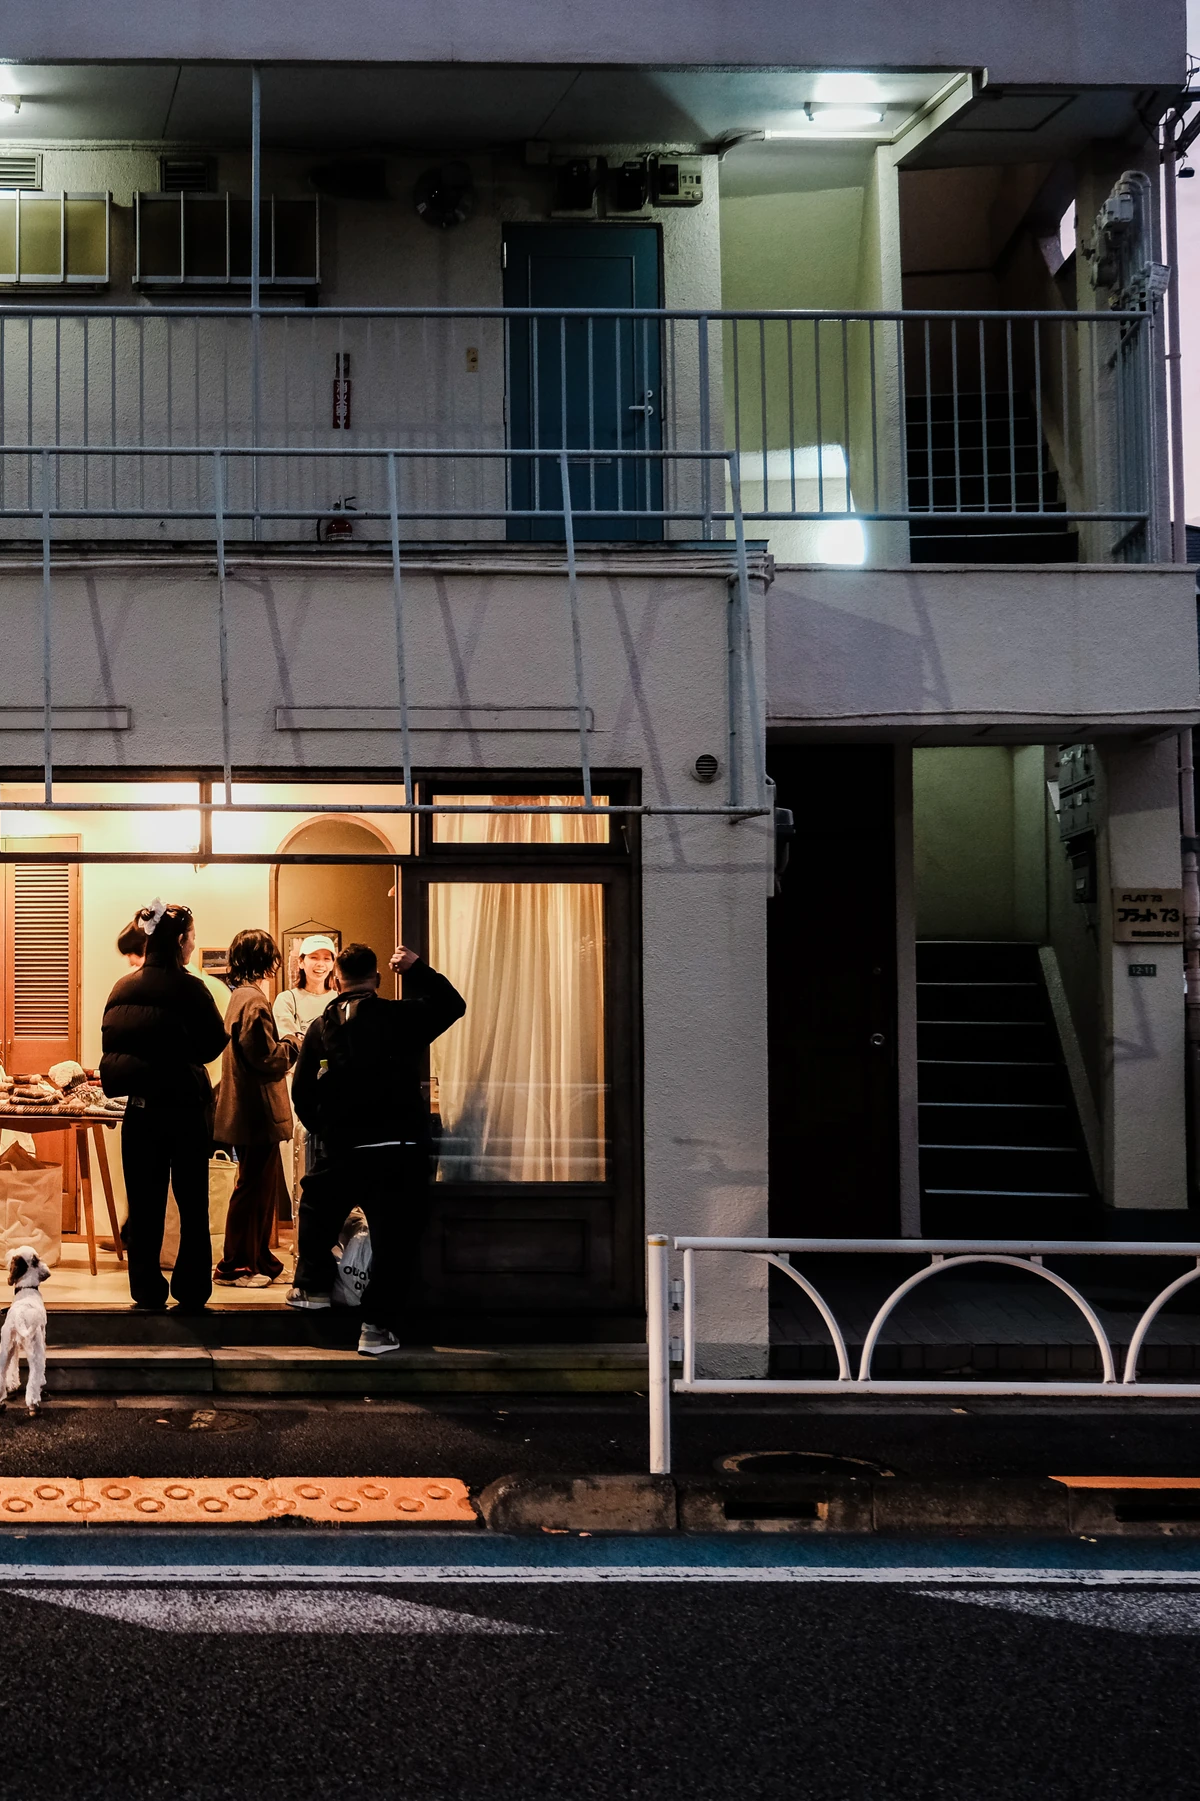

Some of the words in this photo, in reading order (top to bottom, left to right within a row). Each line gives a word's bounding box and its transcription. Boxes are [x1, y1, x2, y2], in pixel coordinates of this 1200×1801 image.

[1122, 894, 1148, 902] FLAT
[1150, 894, 1163, 902] 73
[1117, 908, 1158, 922] フラット
[1159, 908, 1180, 922] 73
[1132, 966, 1154, 975] 12-11
